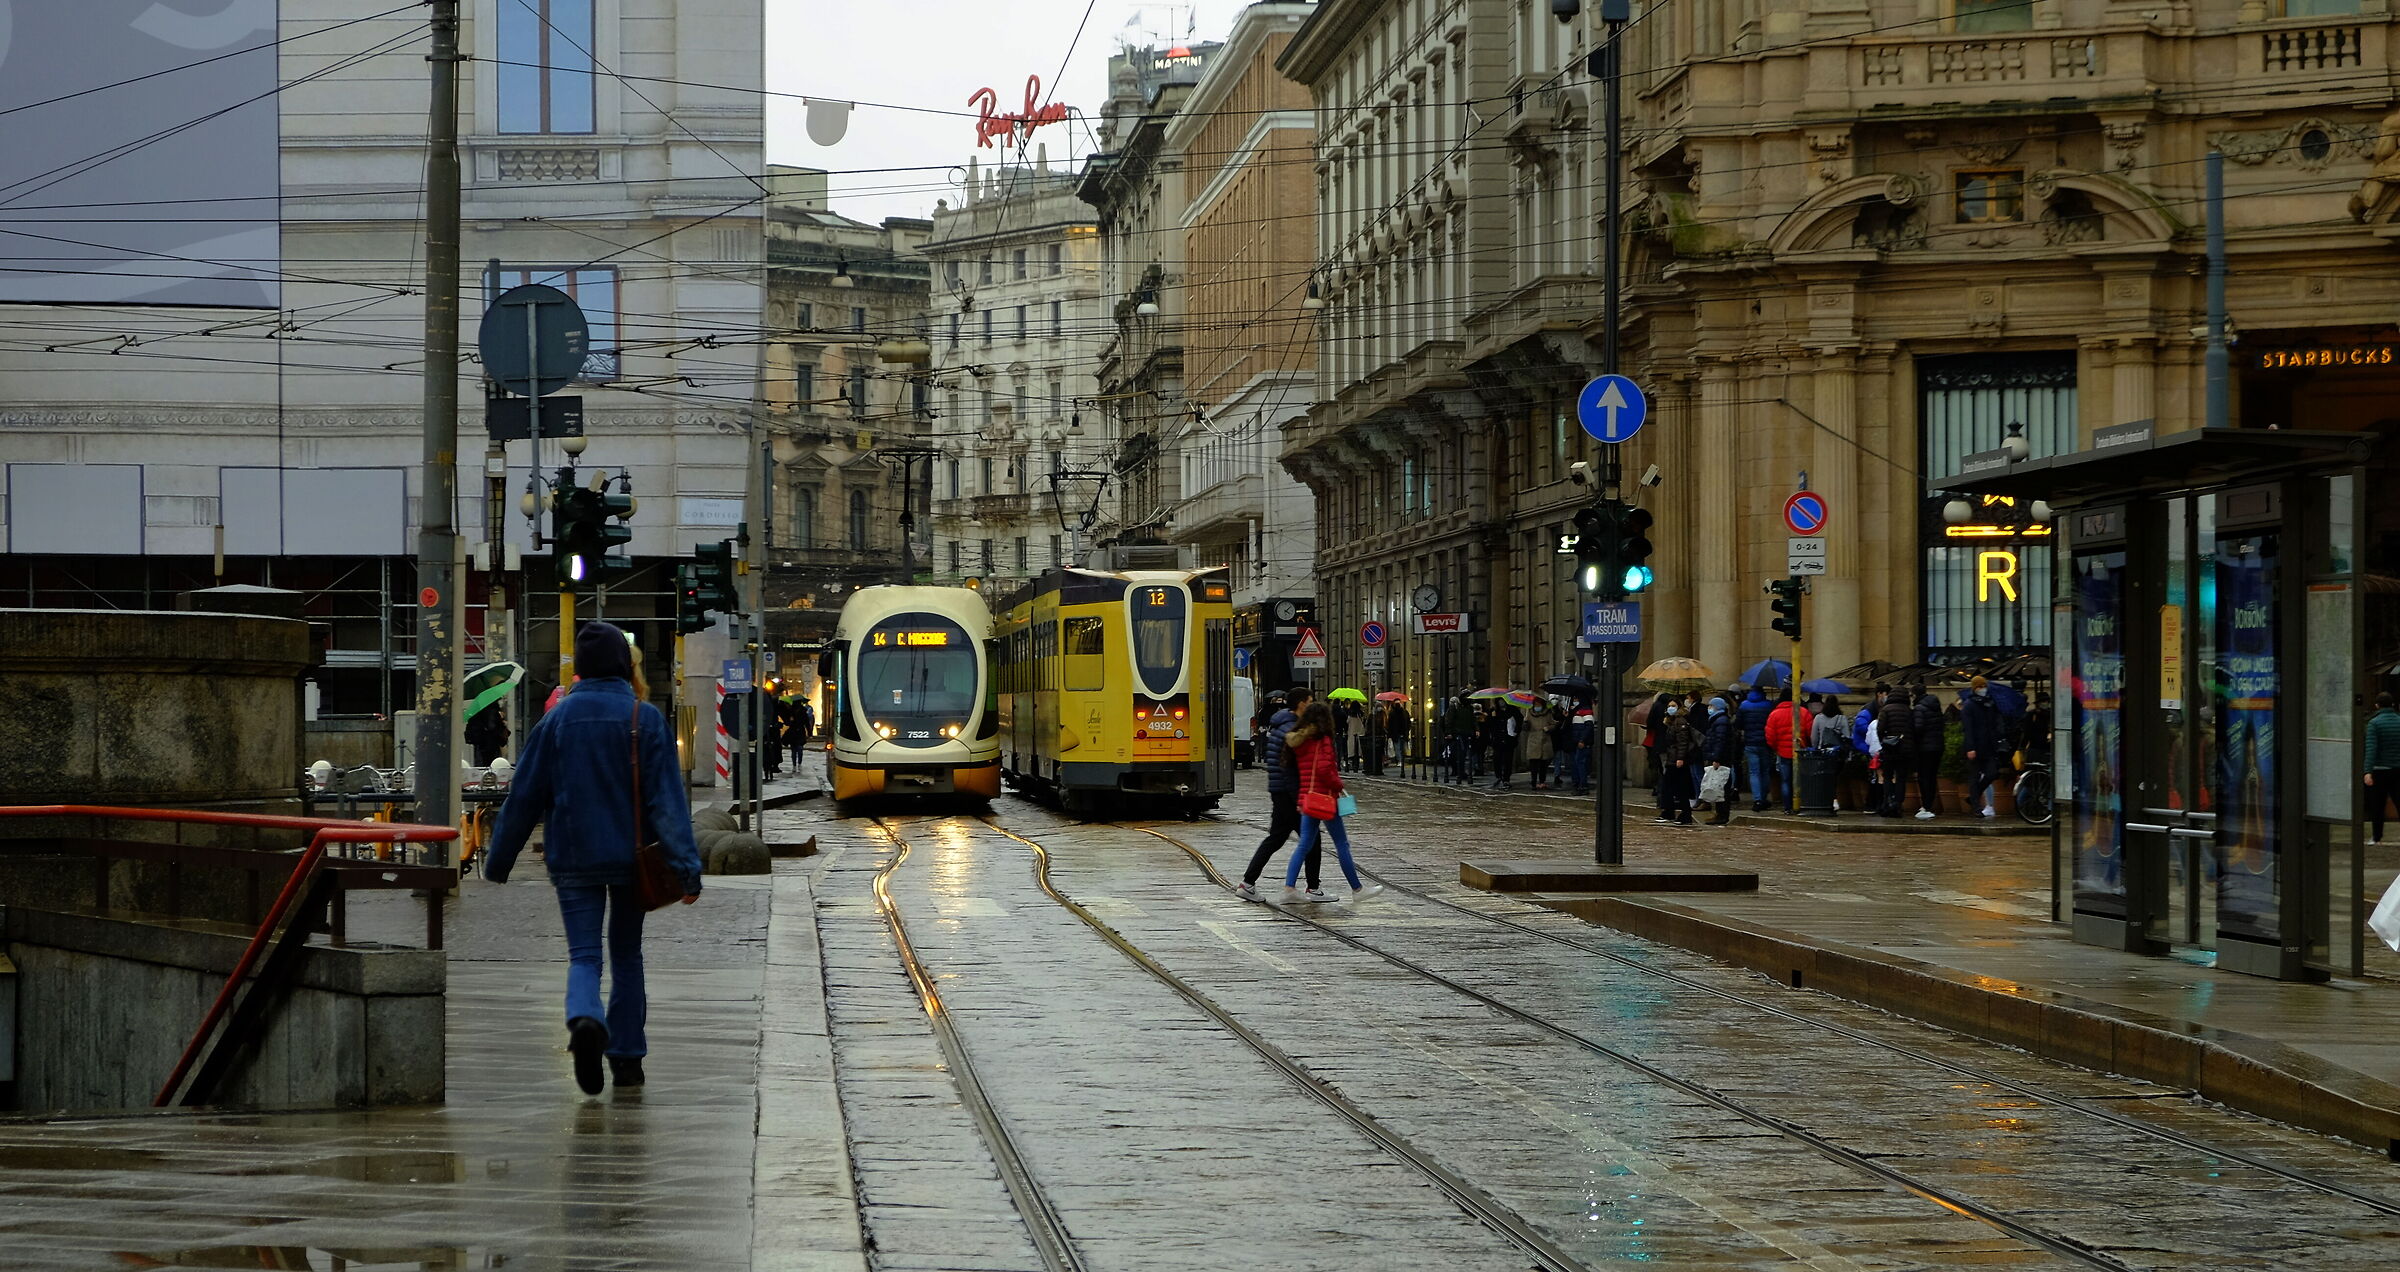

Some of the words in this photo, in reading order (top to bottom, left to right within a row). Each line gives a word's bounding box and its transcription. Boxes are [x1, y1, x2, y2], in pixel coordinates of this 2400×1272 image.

[2263, 347, 2392, 368] STARBUCKS
[1979, 551, 2017, 602] R
[1150, 592, 1165, 605] 12
[1596, 608, 1627, 624] TRAM
[2234, 605, 2267, 629] BORBONE
[1586, 625, 1592, 636] A
[1592, 625, 1613, 636] PASSO
[873, 632, 886, 646] 14
[1148, 721, 1173, 731] 4932
[907, 730, 930, 739] 7522
